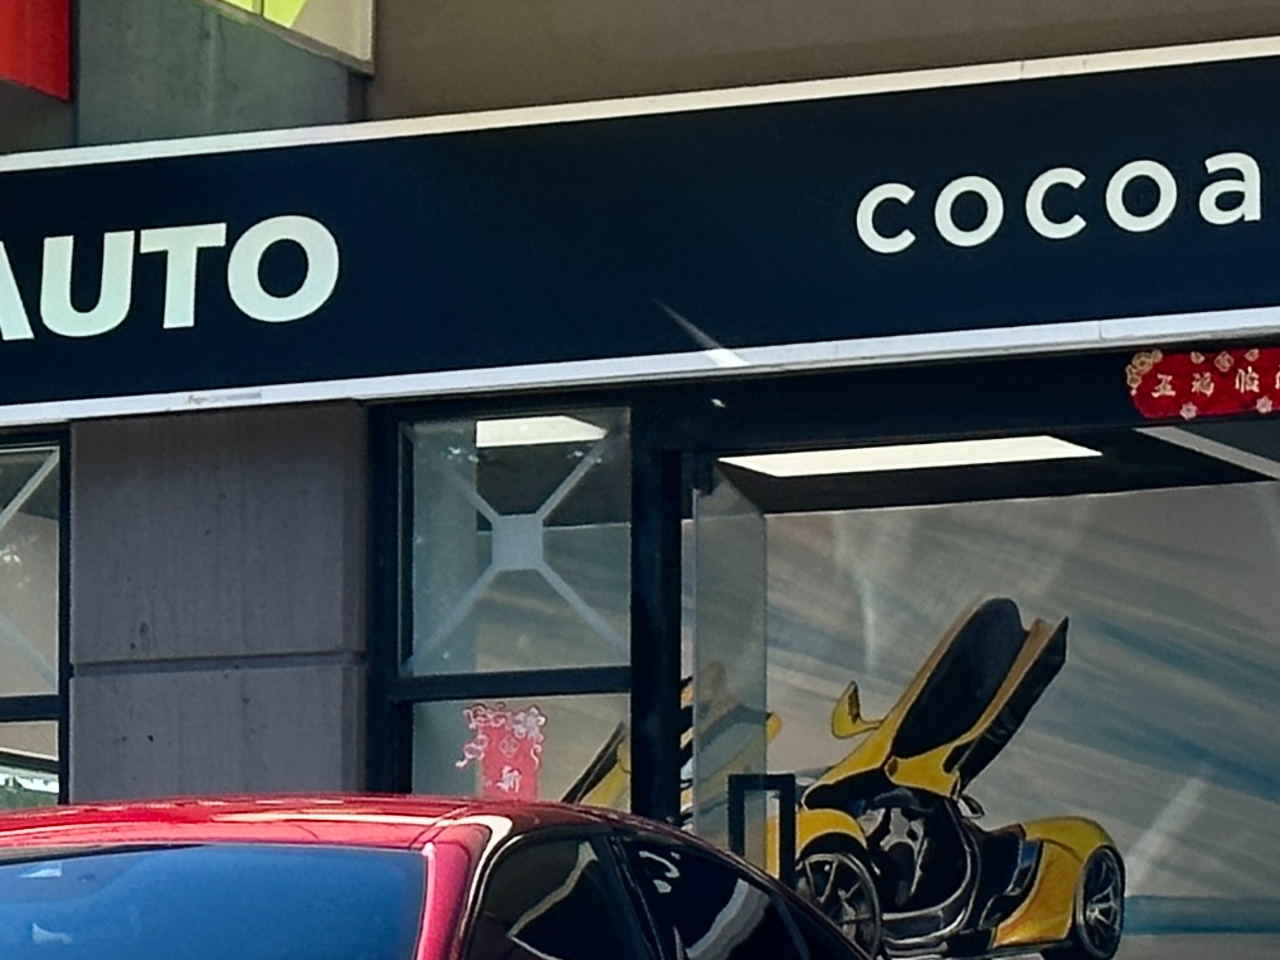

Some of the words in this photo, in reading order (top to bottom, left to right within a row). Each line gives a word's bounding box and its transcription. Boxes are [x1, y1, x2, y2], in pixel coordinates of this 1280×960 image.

[856, 151, 1262, 254] cocoa
[1151, 365, 1280, 398] 五福临
